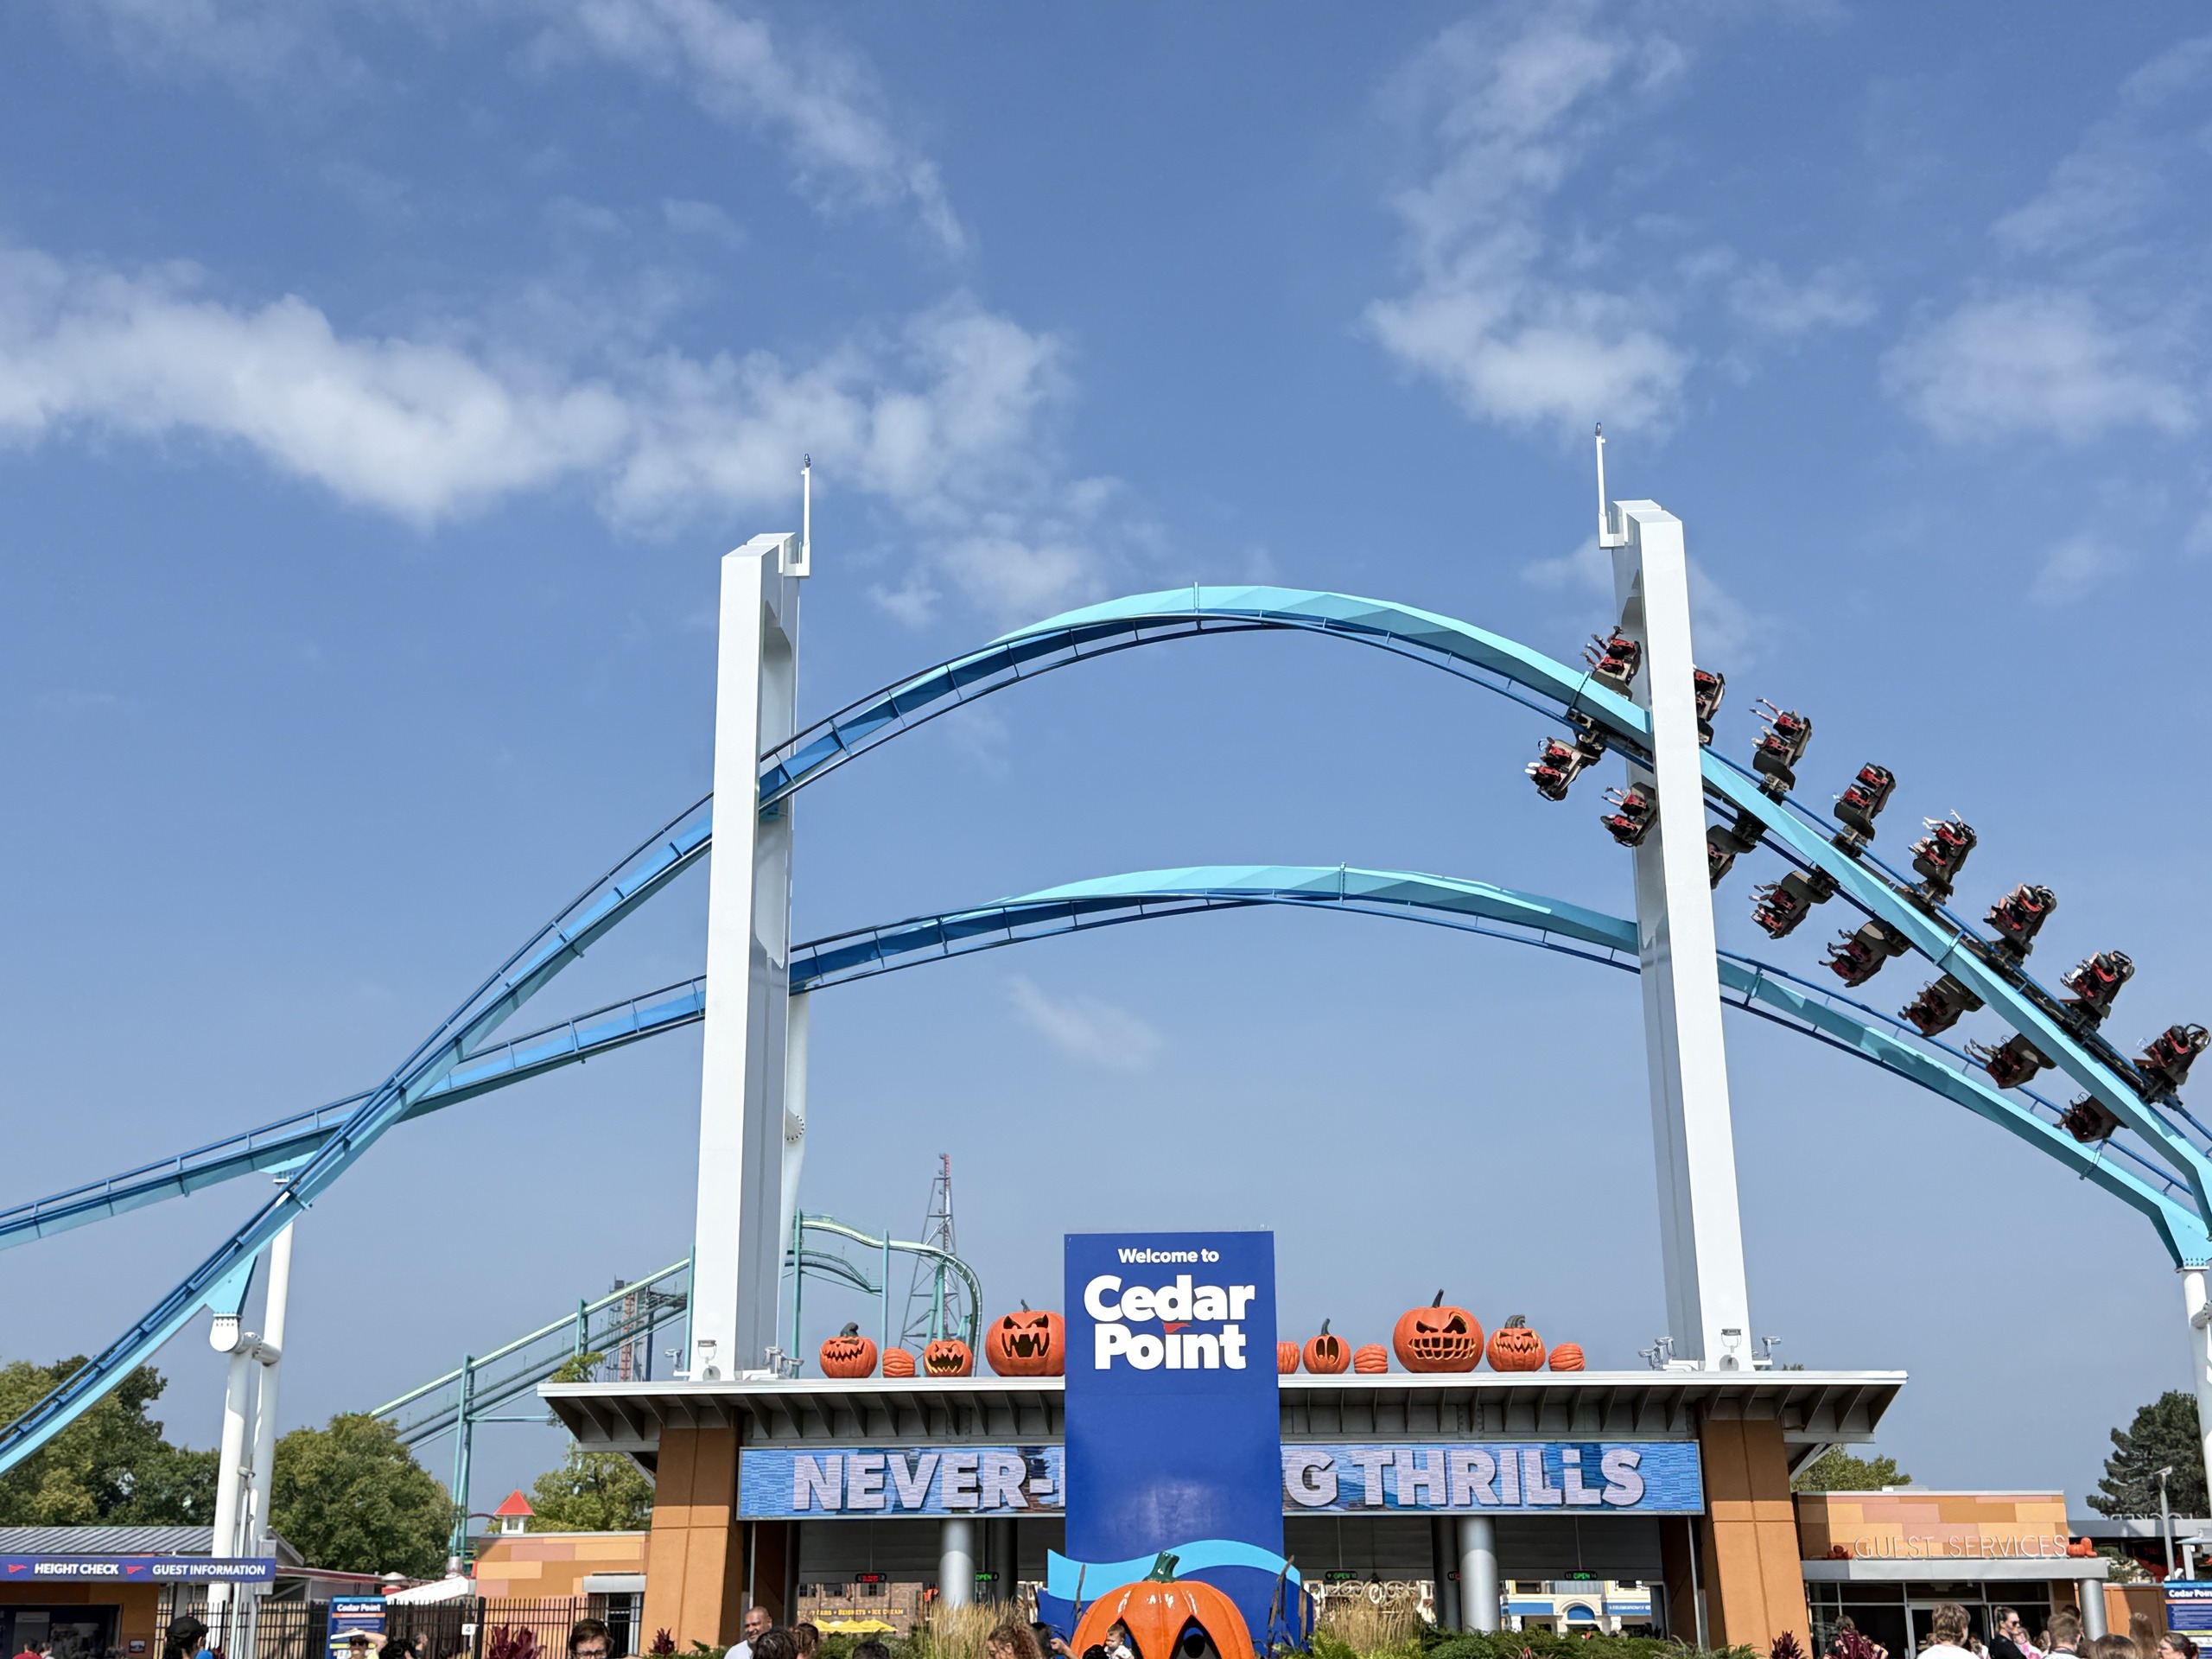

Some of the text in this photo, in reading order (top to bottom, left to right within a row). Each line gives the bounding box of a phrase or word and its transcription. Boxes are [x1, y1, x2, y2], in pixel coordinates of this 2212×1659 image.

[1117, 1248, 1220, 1264] Welcome to
[1084, 1274, 1255, 1322] Cedar
[1094, 1322, 1247, 1370] Point
[792, 1453, 1065, 1510] NEVER-
[1350, 1448, 1644, 1507] THRILLS
[1853, 1534, 2068, 1559] GUEST SERVICES
[34, 1562, 119, 1575] HEIGHT CHECK
[152, 1564, 266, 1576] GUEST INFORMATION
[2168, 1589, 2193, 1598] Cedar
[336, 1603, 381, 1612] Cedar Point
